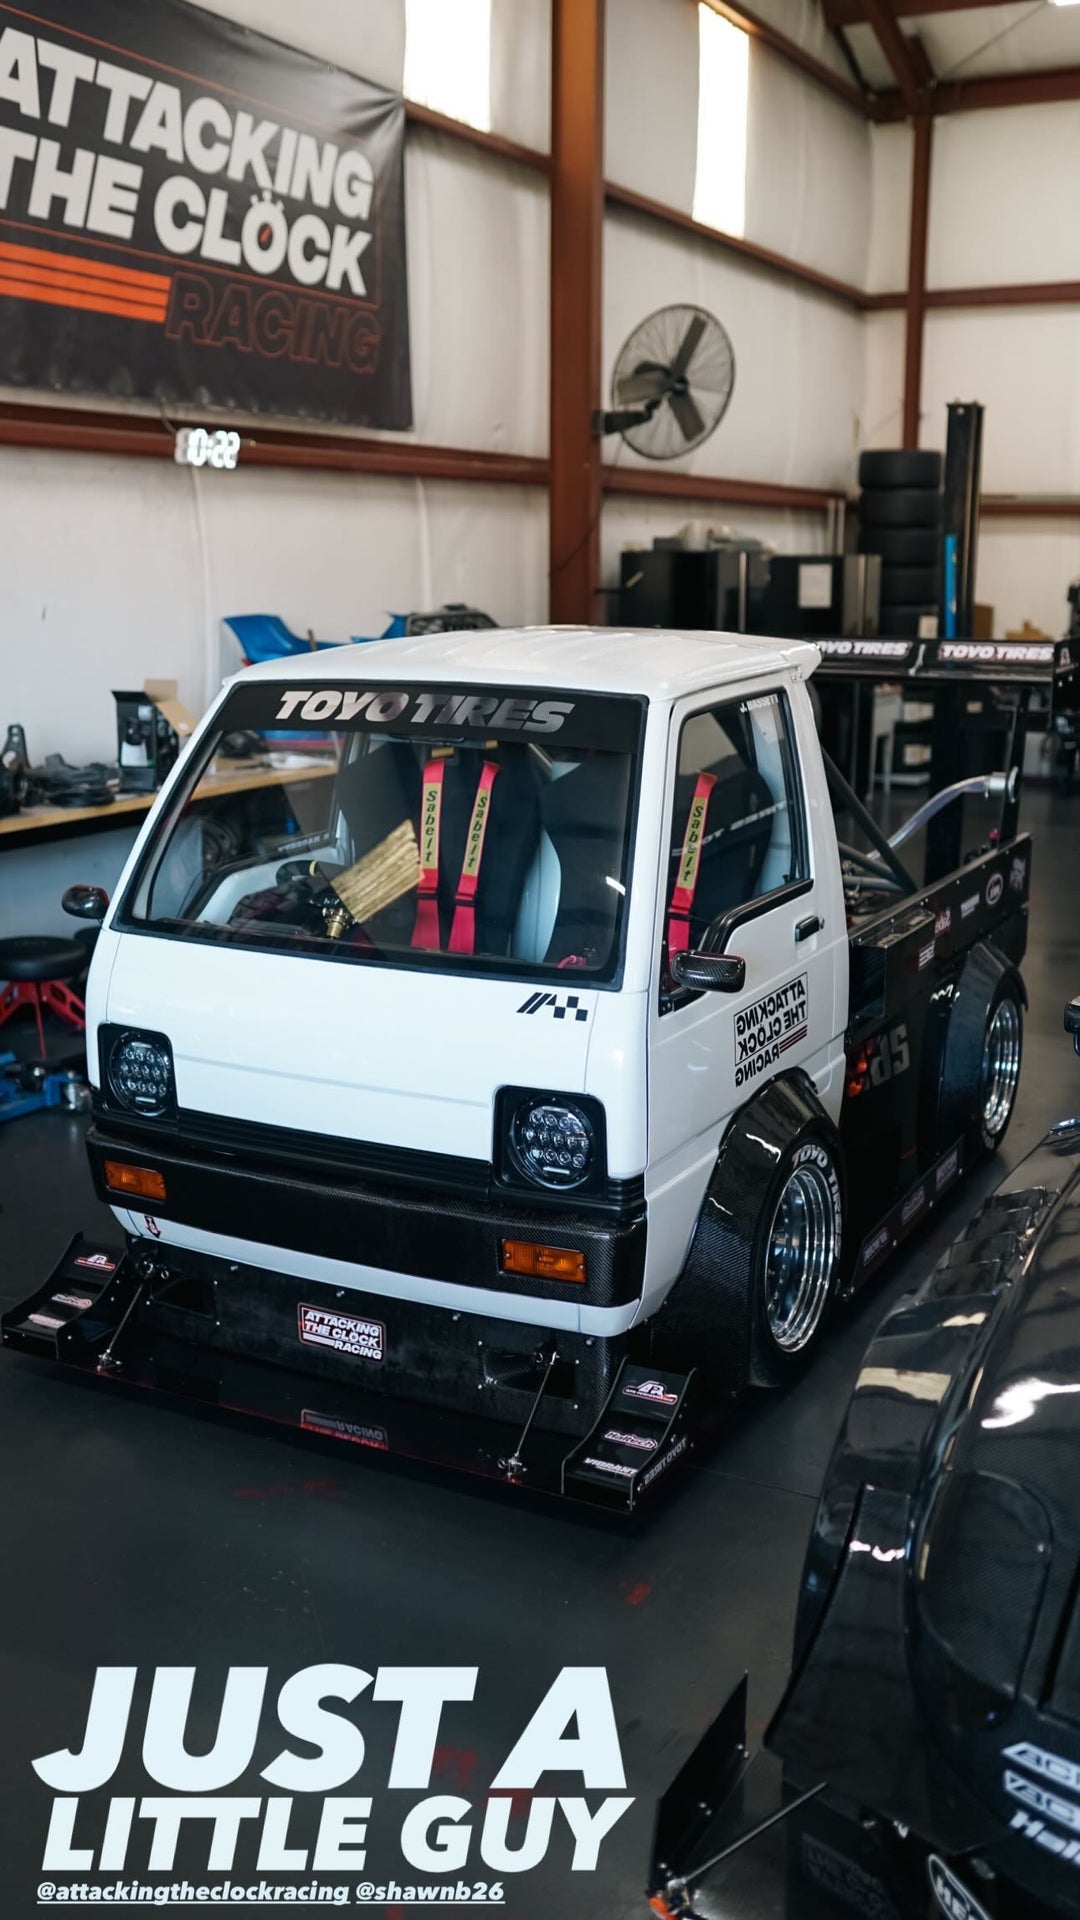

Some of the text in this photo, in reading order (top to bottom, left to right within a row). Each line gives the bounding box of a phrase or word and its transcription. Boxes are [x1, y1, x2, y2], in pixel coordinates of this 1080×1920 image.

[0, 27, 375, 221] ATTACKING
[0, 125, 144, 240] THE
[165, 272, 382, 375] RACING
[853, 641, 908, 656] TIRES
[942, 644, 996, 660] TOYO
[995, 645, 1054, 662] TIRES
[275, 690, 576, 733] TOYO TIRES
[425, 790, 438, 862] Sabelt
[468, 796, 488, 868] Sabelt
[683, 805, 704, 882] Sabelt
[792, 1144, 829, 1170] TOYO
[304, 1321, 379, 1348] THE CLOCK
[305, 1312, 380, 1337] ATTACKING
[334, 1341, 382, 1360] RACING
